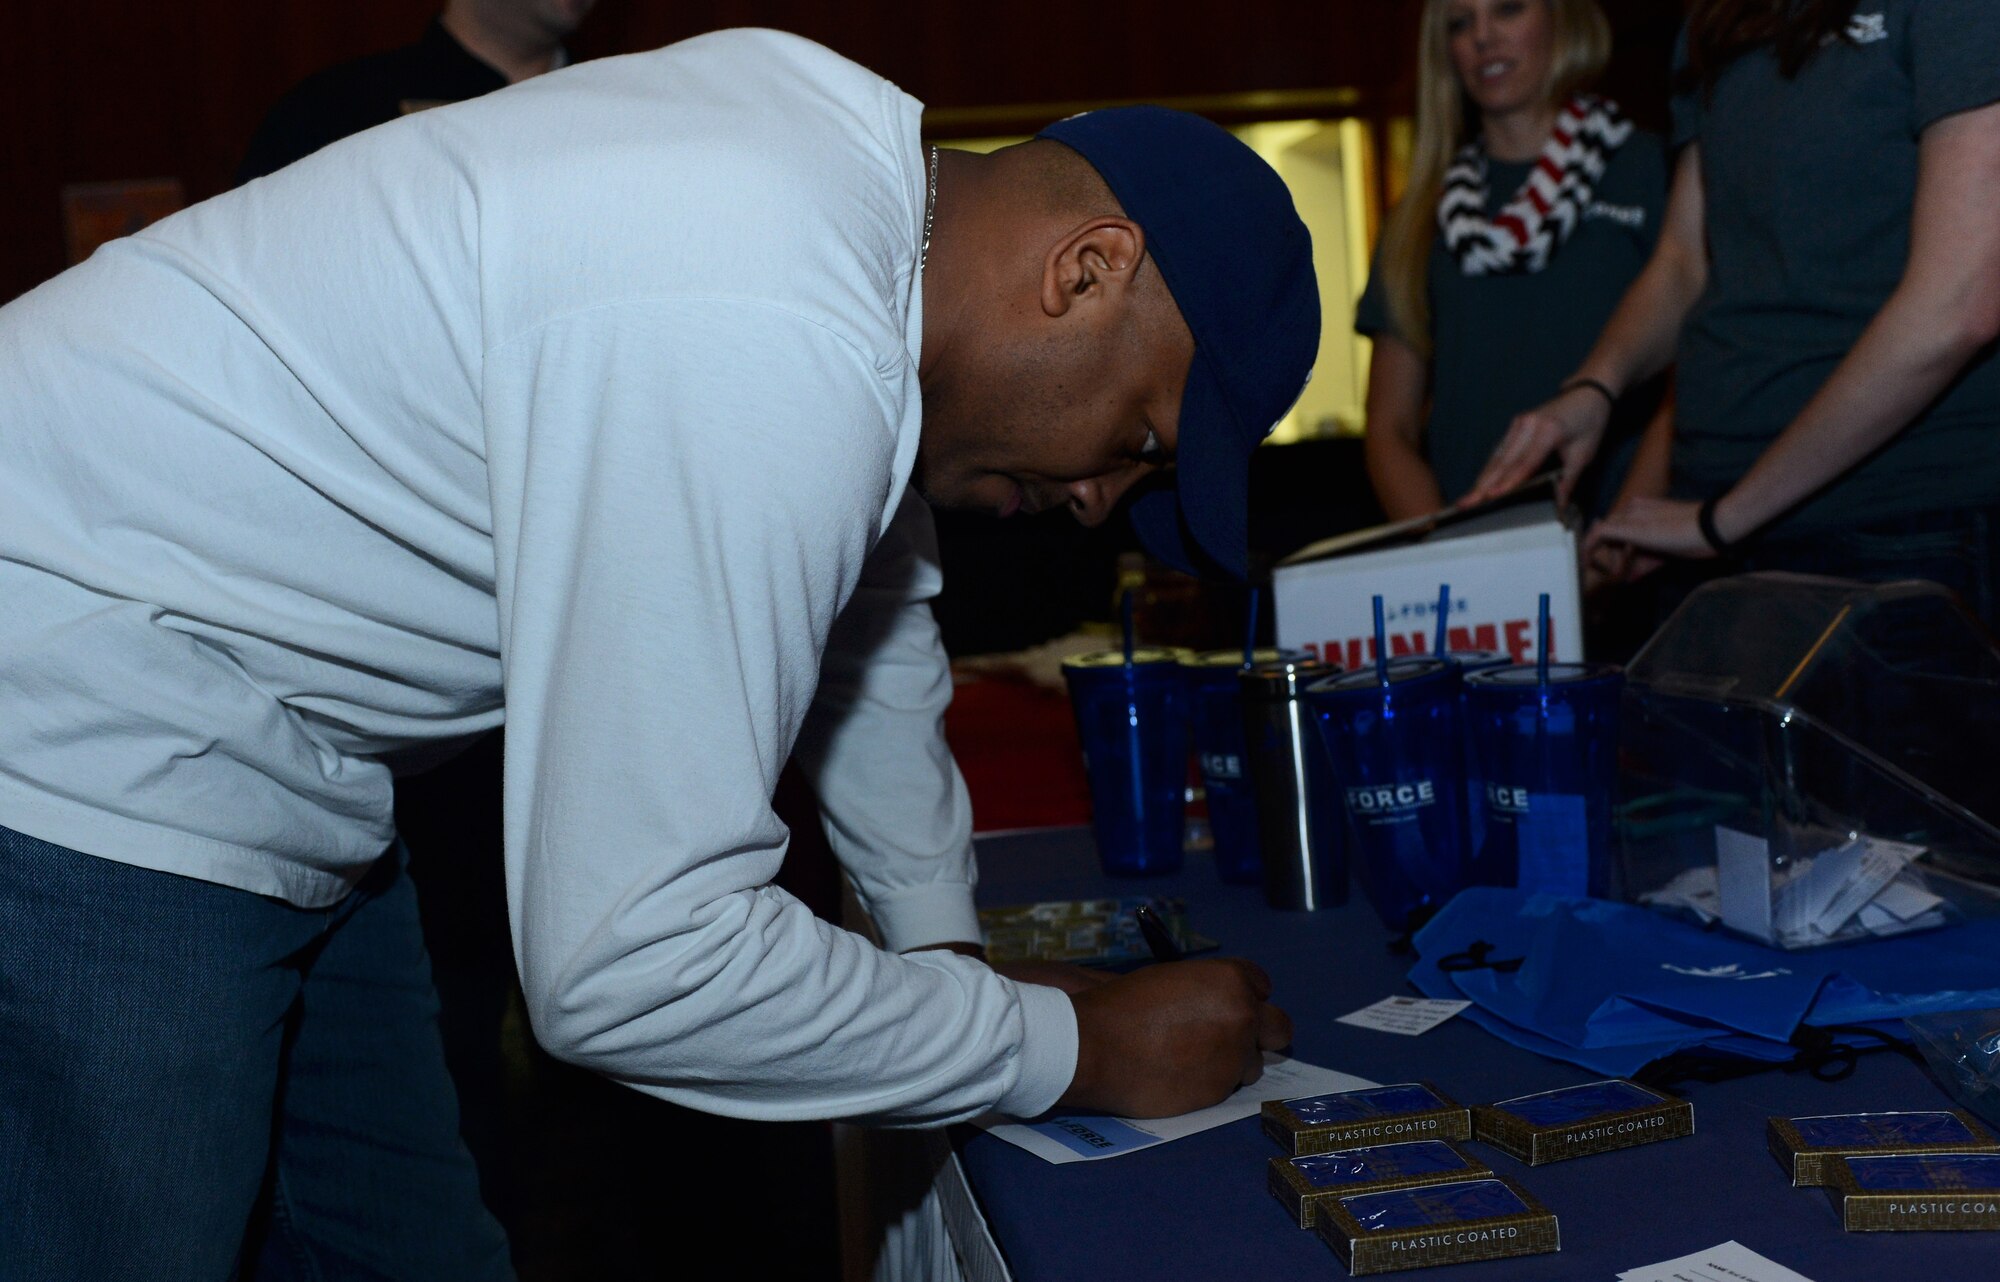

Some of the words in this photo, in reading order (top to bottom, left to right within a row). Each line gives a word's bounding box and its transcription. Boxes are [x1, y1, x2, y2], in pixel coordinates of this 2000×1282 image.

[1329, 1127, 1381, 1142] PLASTIC
[1385, 1119, 1437, 1135] COATED
[1566, 1126, 1614, 1144] PLASTIC
[1617, 1116, 1665, 1134] COATED
[1889, 1203, 1956, 1214] PLASTIC
[1391, 1235, 1452, 1252] PLASTIC
[1457, 1227, 1517, 1244] COATED
